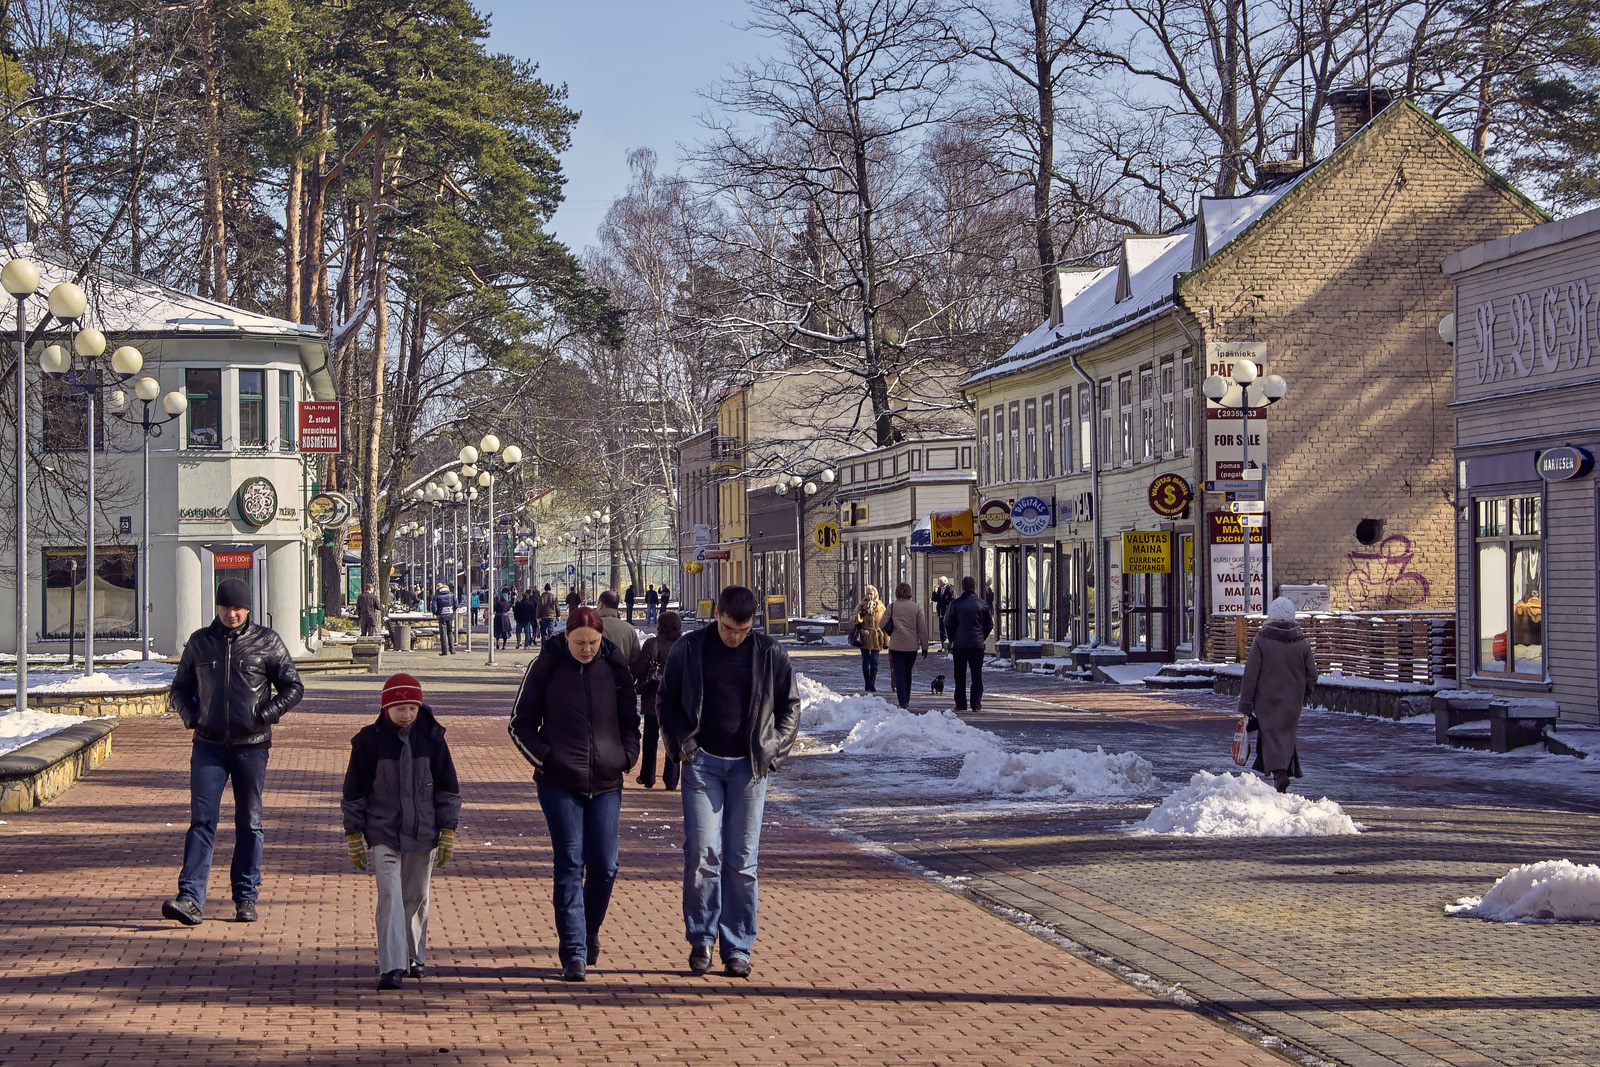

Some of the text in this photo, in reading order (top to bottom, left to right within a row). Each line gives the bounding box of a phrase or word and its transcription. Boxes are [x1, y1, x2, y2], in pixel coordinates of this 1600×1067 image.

[1217, 348, 1256, 358] Īpašnieks
[1210, 361, 1263, 377] PĀRD
[1222, 409, 1257, 417] 2935933
[308, 414, 315, 423] 2.
[302, 435, 337, 448] KOSMĒTIKA
[1214, 434, 1234, 446] FOR
[1220, 471, 1243, 479] (pagal
[936, 529, 963, 538] Kodak
[1126, 533, 1167, 543] VALŪTAS
[1129, 556, 1165, 564] CURRENCY
[1218, 604, 1262, 612] EXCHNG
